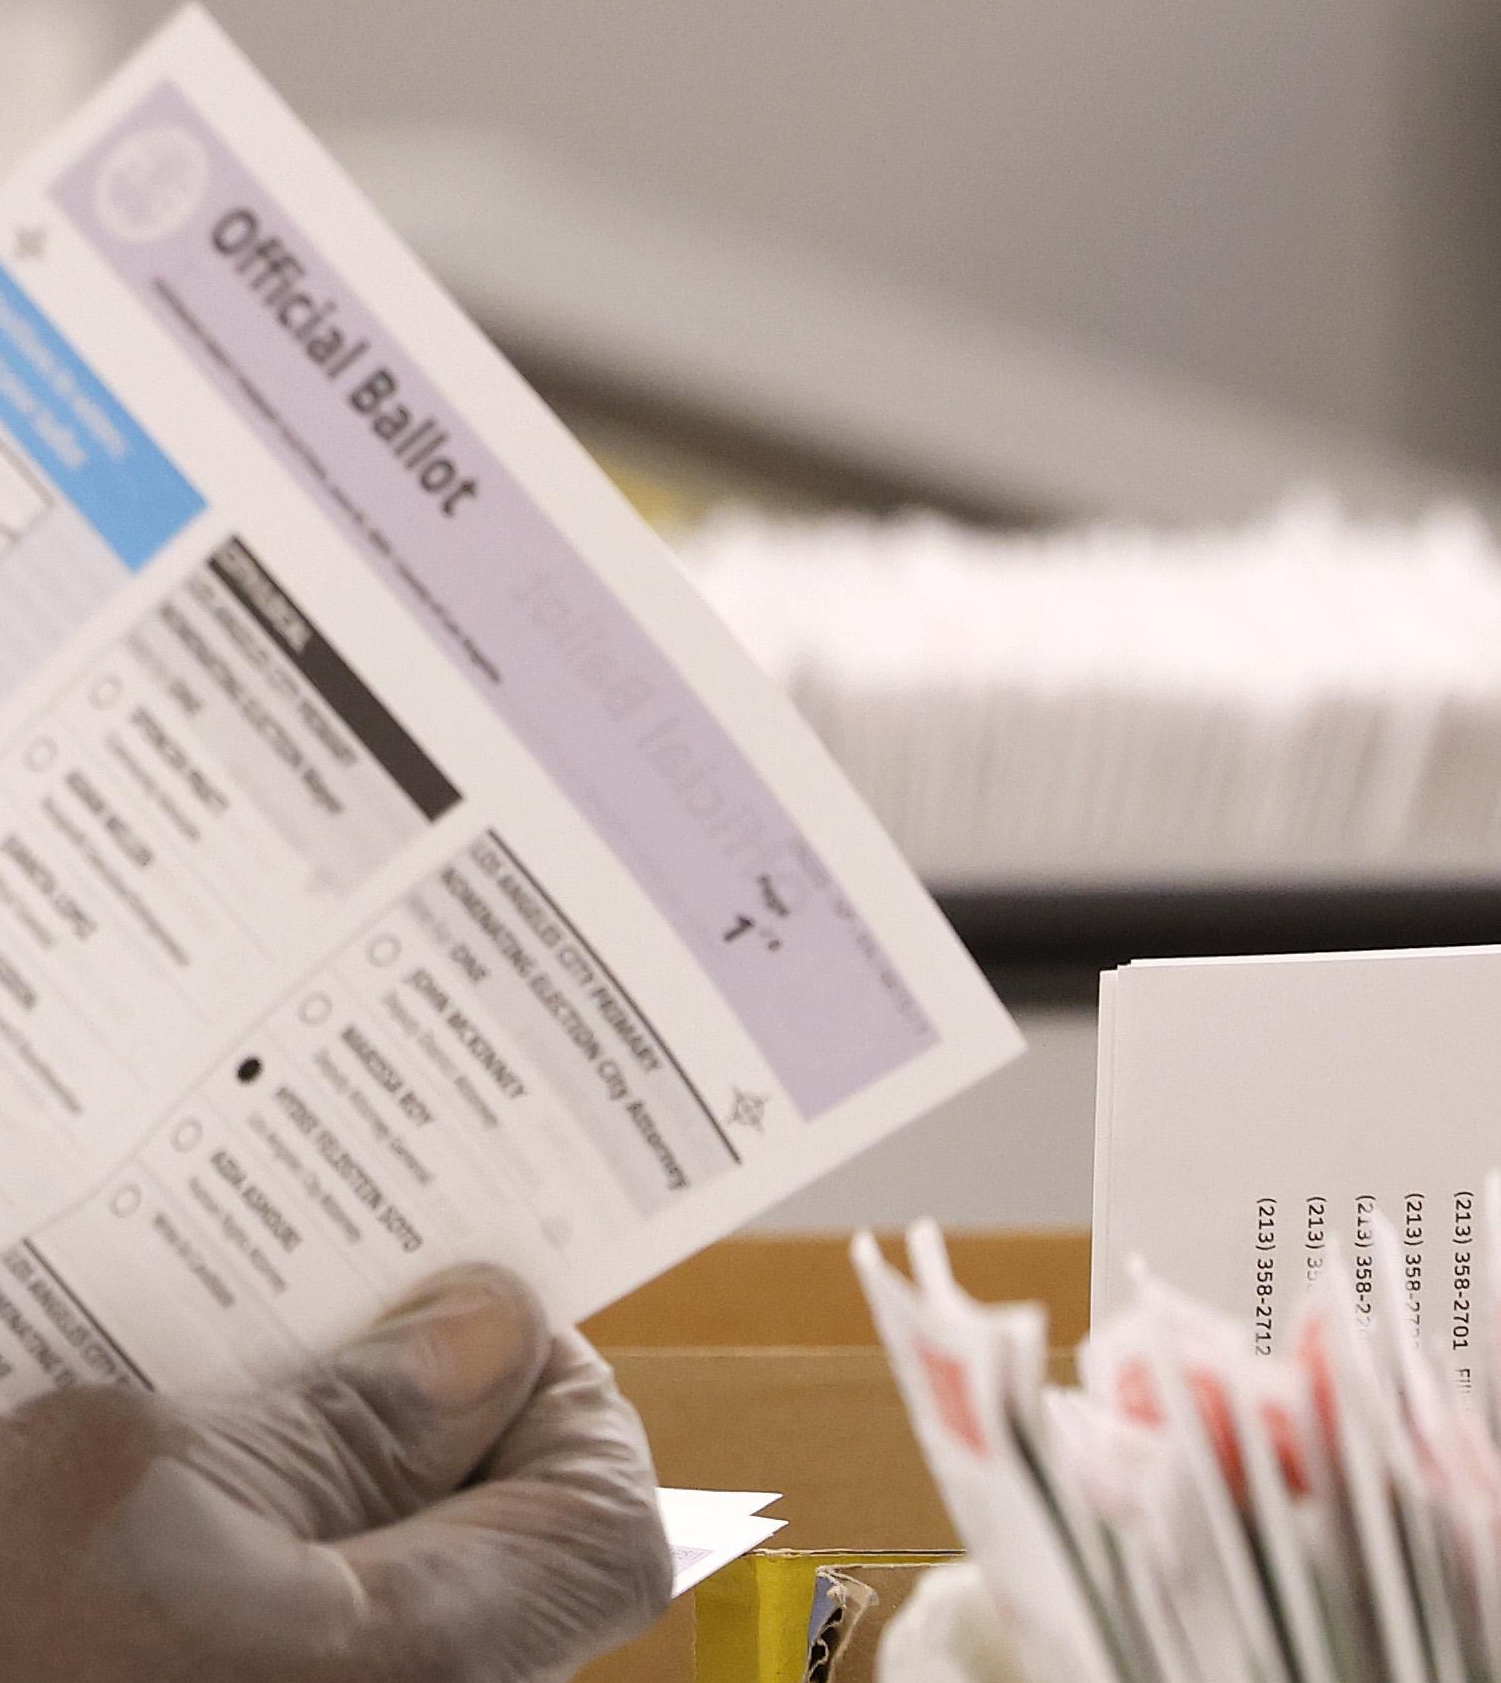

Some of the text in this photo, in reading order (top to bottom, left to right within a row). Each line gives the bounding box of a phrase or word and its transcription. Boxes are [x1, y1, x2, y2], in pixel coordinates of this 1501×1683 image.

[210, 208, 477, 516] Official Ballot
[722, 913, 755, 943] 1
[496, 874, 562, 948] ANGELES
[555, 944, 596, 986] CITY
[589, 984, 662, 1074] PRIMARY
[440, 866, 689, 1191] NOMINATING ELECTION City Attorney
[1304, 1196, 1326, 1250] (213)
[1353, 1195, 1376, 1249] (213)
[1402, 1193, 1424, 1247] (213)
[1451, 1191, 1473, 1245] (213)
[1253, 1198, 1276, 1357] (213) 358-2712
[1451, 1252, 1470, 1351] 358-2701
